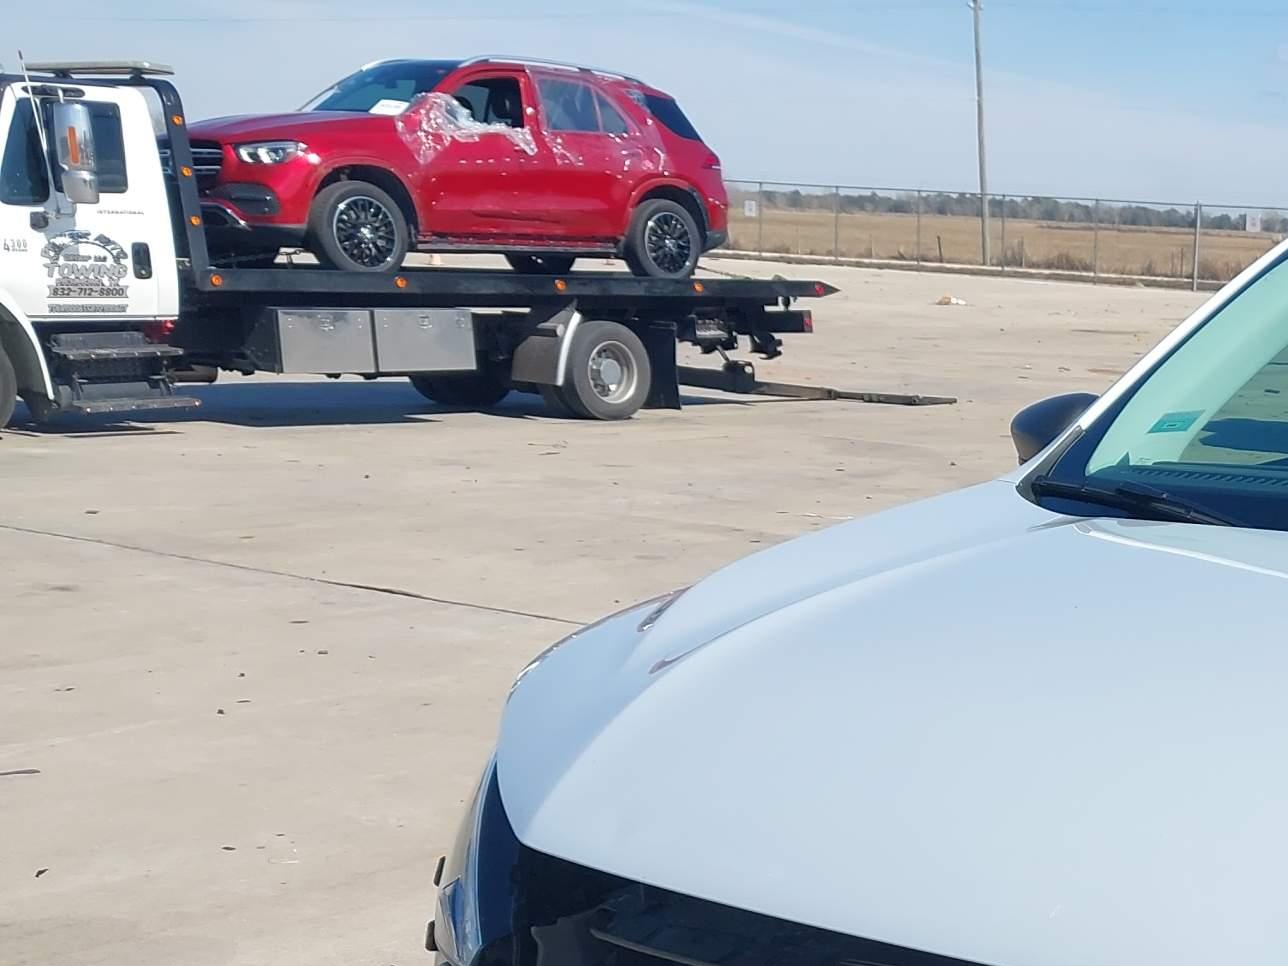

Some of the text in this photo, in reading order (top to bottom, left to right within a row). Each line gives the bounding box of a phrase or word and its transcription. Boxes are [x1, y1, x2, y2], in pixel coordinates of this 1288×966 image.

[3, 238, 28, 252] 4300
[43, 262, 129, 279] TOWING
[52, 287, 125, 297] 832-712-8800
